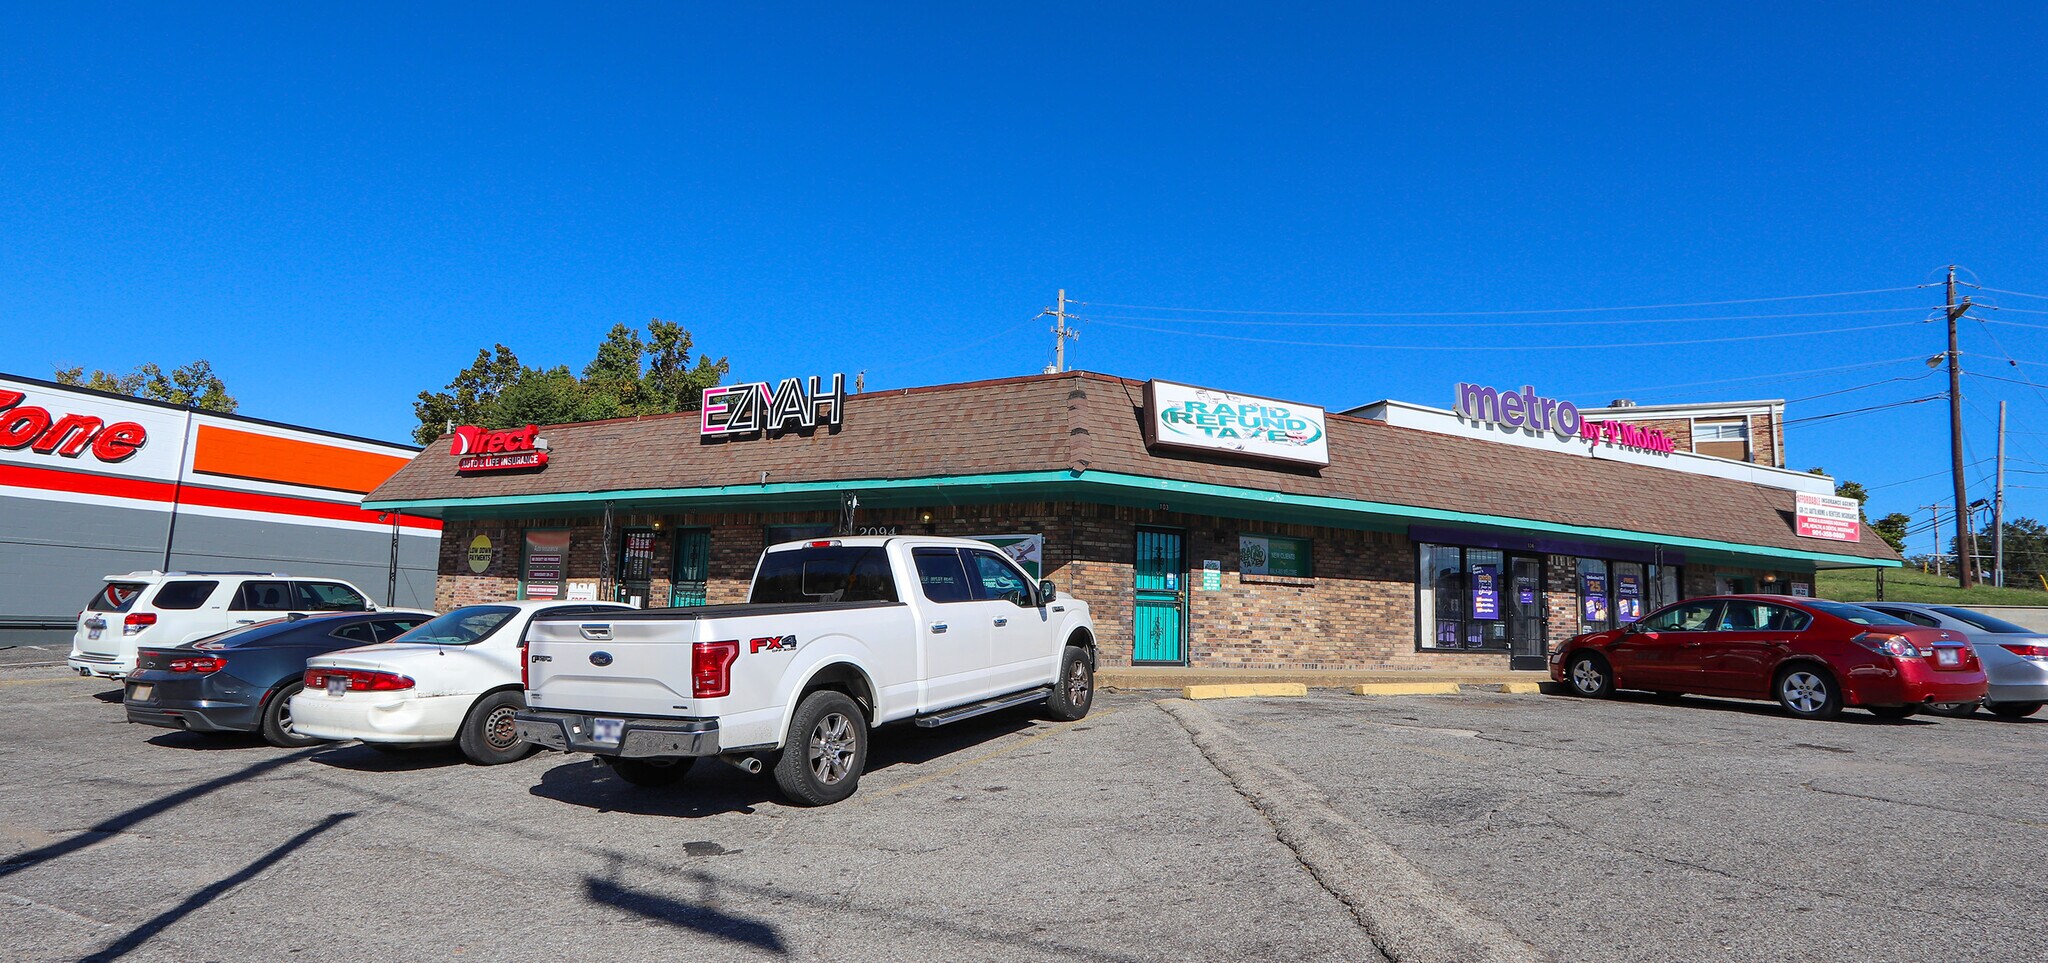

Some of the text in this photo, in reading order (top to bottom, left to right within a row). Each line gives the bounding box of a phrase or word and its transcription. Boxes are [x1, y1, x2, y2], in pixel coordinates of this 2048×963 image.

[701, 373, 845, 435] EZIYAH
[1185, 401, 1290, 418] RAPID
[1170, 412, 1307, 430] REFUND
[1457, 382, 1580, 436] metro
[1580, 415, 1600, 446] by
[450, 424, 539, 455] Direct
[461, 460, 478, 468] AUTO
[485, 458, 499, 467] LIFE
[501, 455, 538, 466] INSURANCE
[859, 526, 897, 536] 2094
[750, 635, 797, 654] FX4
